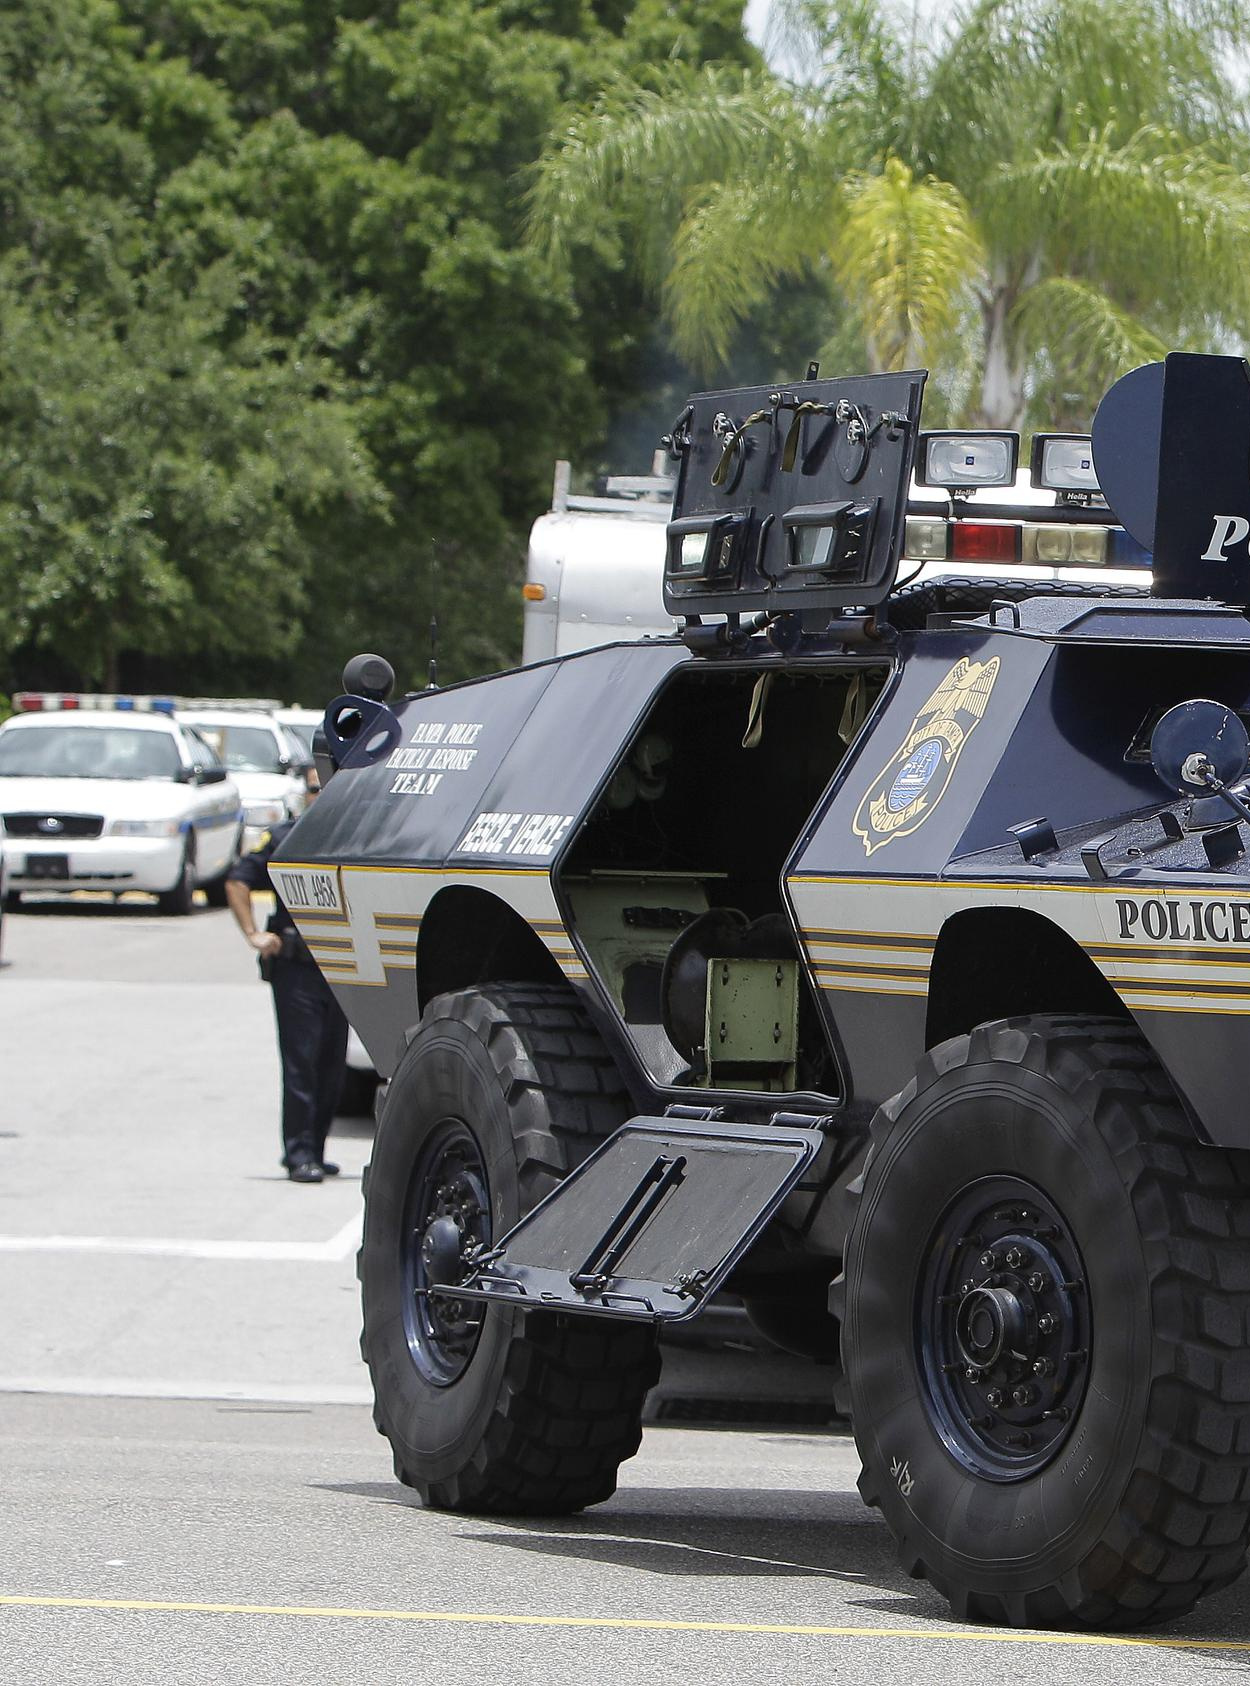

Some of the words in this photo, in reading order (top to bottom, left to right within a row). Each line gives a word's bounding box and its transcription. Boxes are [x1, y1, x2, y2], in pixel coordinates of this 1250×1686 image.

[1066, 492, 1088, 500] Hella
[442, 723, 484, 745] POLICE
[426, 748, 478, 771] RESPONSE
[389, 772, 444, 795] TEAM
[872, 804, 912, 830] POLICE
[456, 812, 523, 853] RESCUE
[505, 814, 575, 856] VEHICLE
[280, 873, 310, 906] UNIT
[310, 874, 337, 908] 4958
